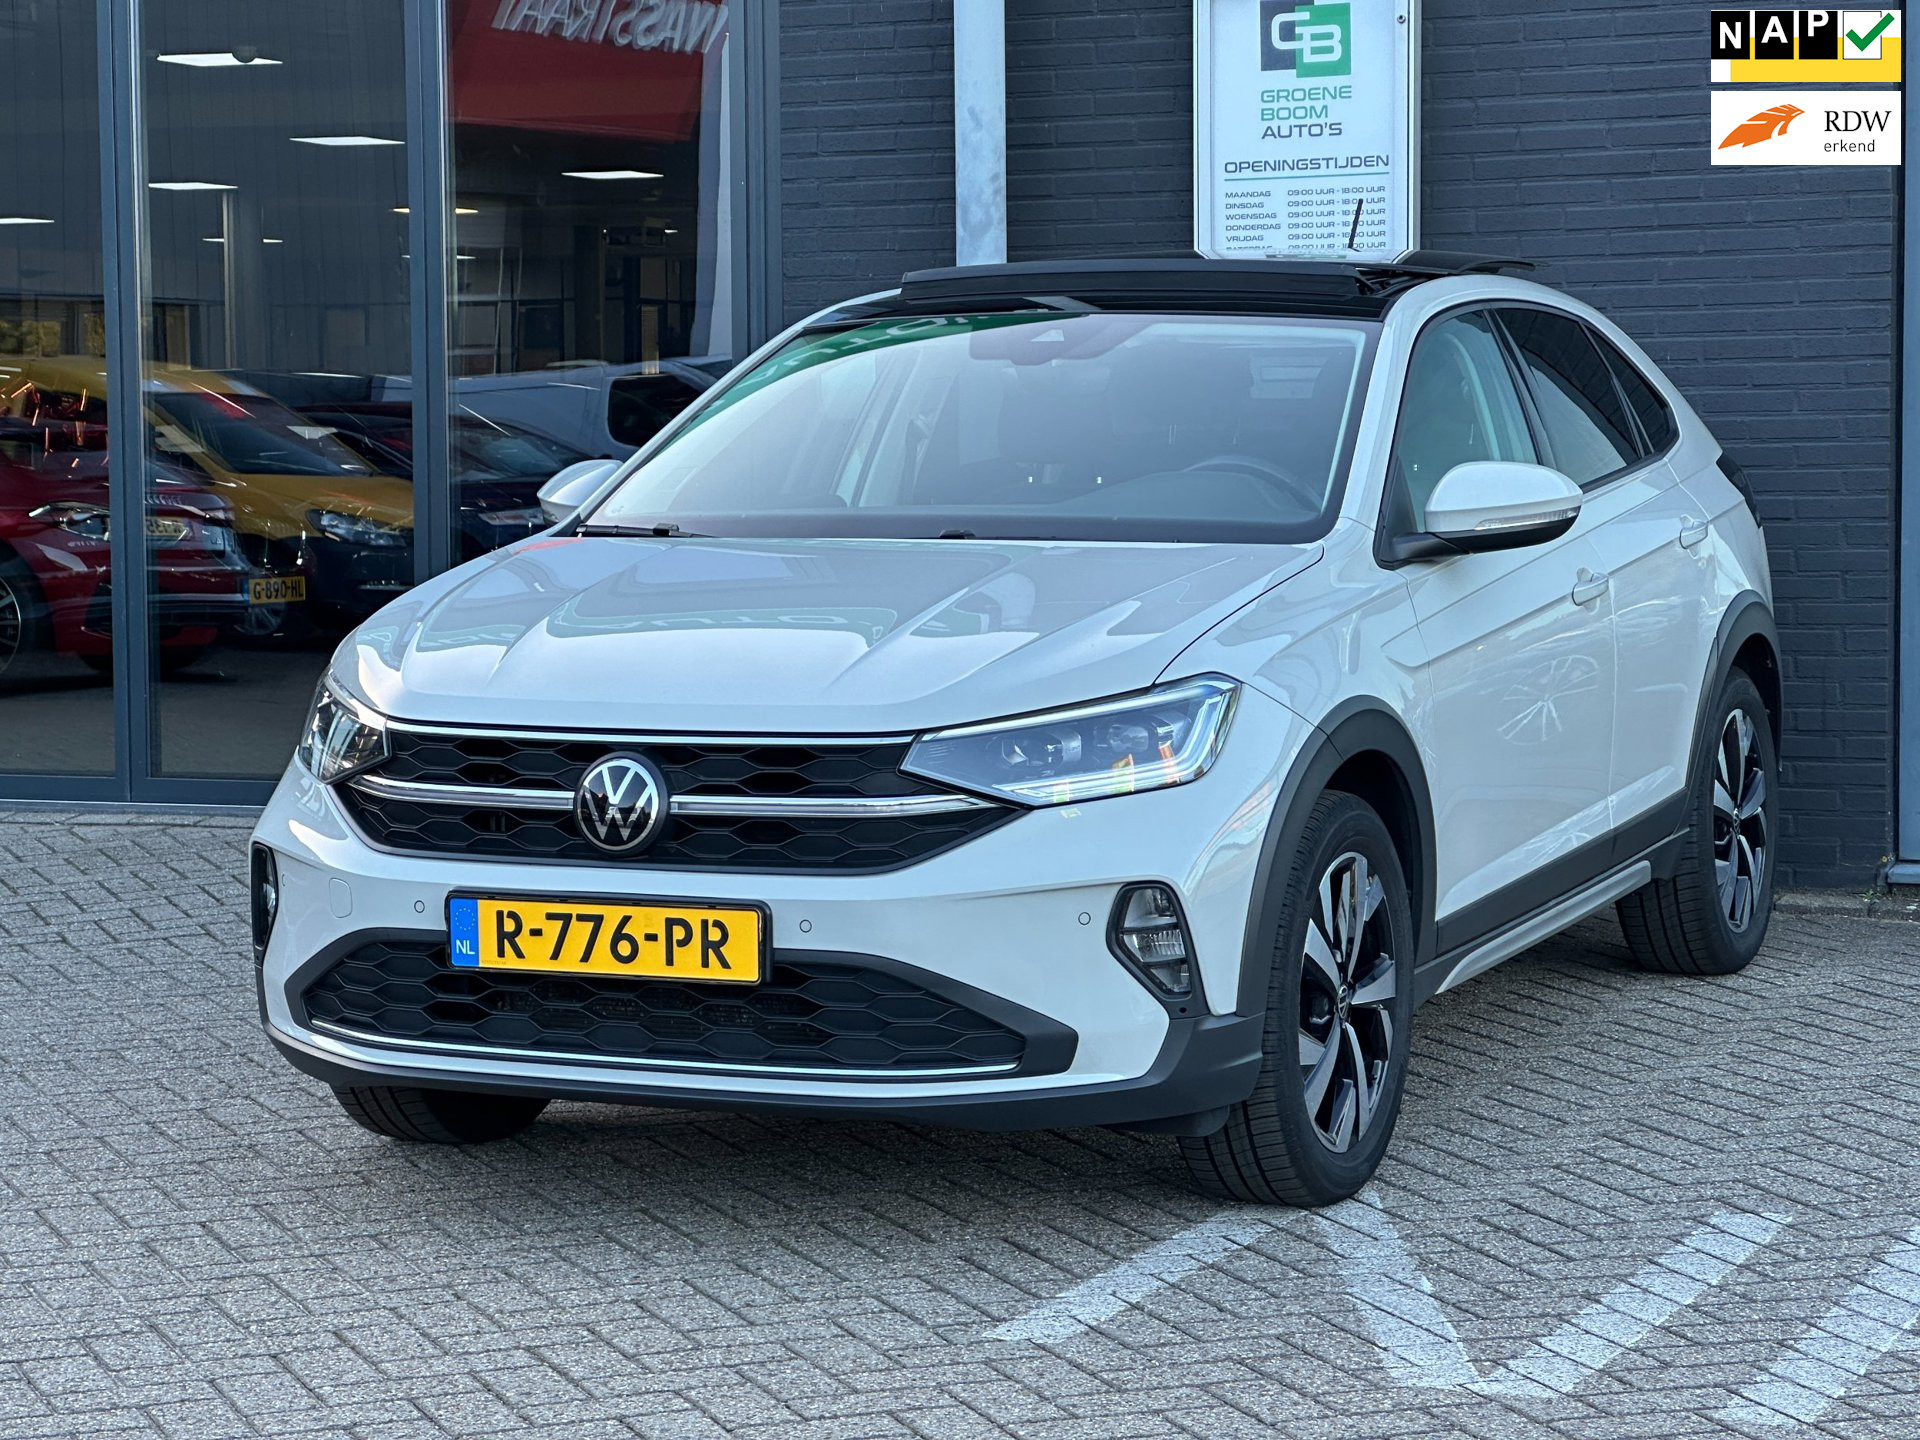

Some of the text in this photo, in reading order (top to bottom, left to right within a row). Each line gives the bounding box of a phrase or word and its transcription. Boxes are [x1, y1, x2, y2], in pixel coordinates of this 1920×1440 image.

[1260, 85, 1353, 103] GROENE
[1260, 104, 1329, 121] BOOM
[1261, 122, 1343, 139] AUTO'S
[1224, 154, 1390, 174] OPENINGSTIJDEN
[1225, 190, 1271, 198] MAANDAG
[253, 579, 304, 600] G-890-HL
[455, 939, 476, 955] NL
[495, 909, 732, 970] R-776-PR
